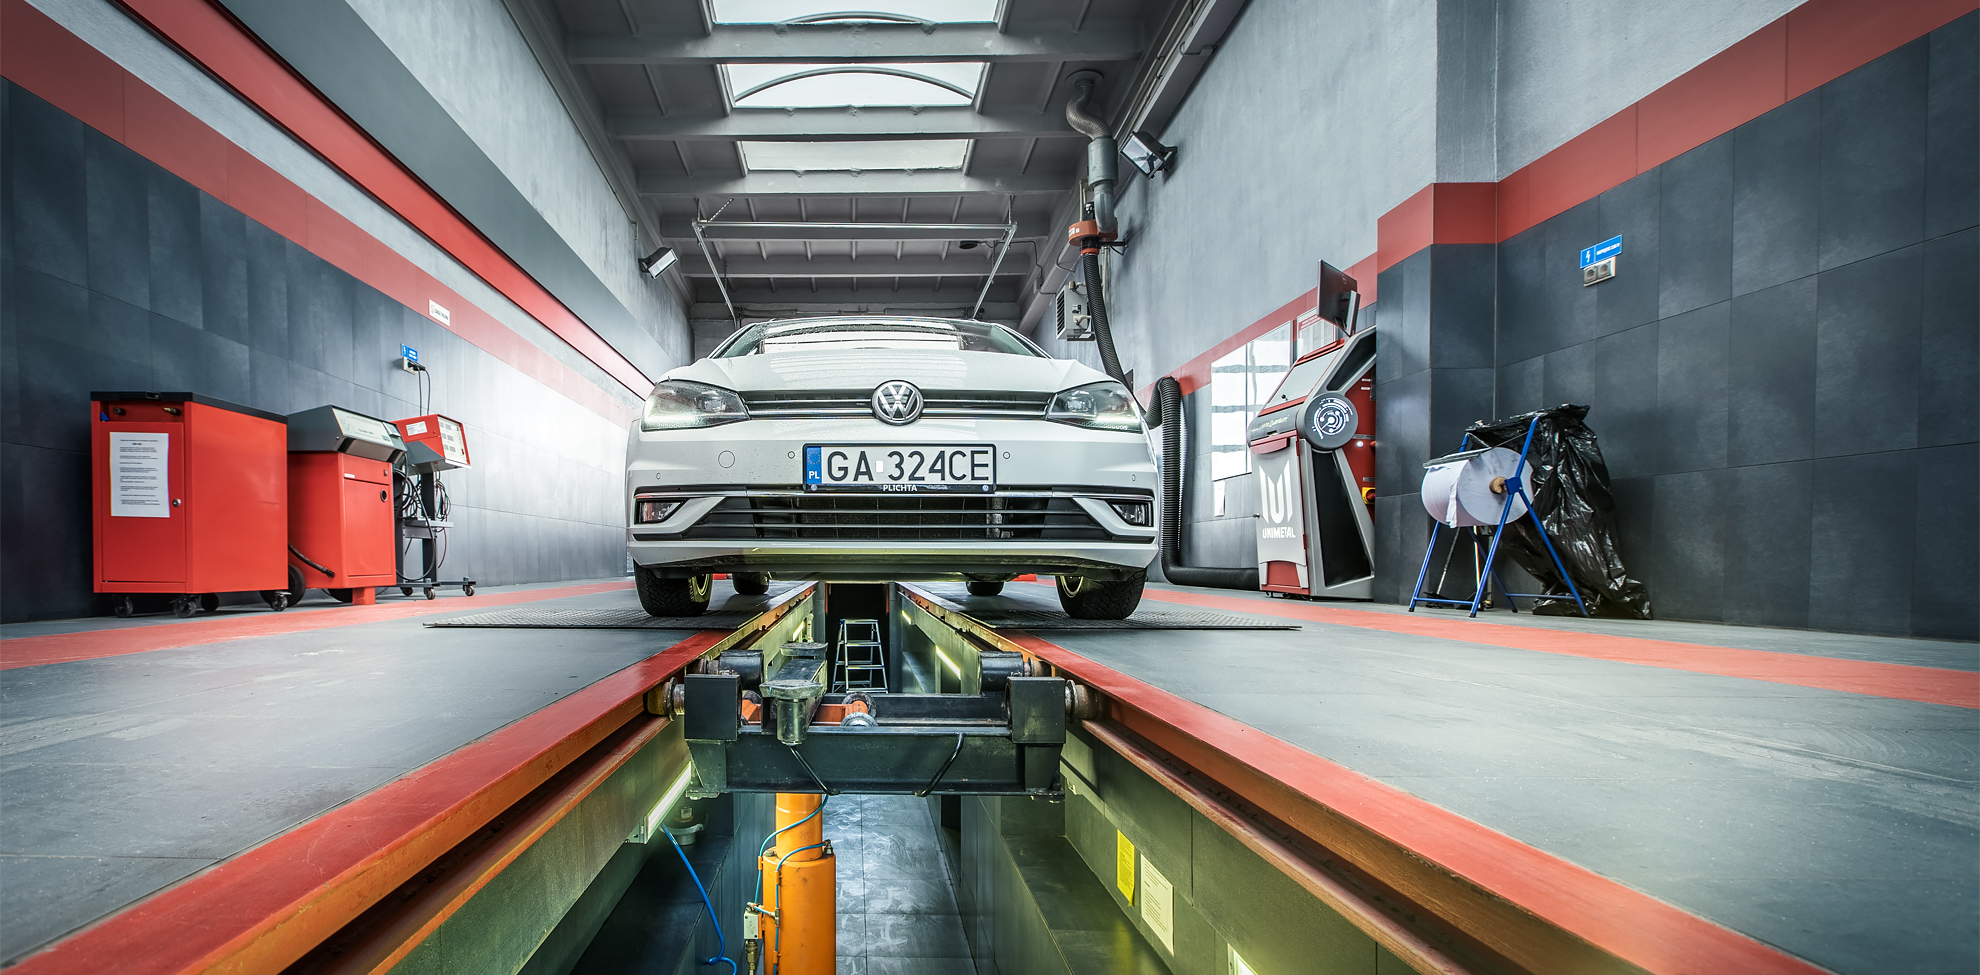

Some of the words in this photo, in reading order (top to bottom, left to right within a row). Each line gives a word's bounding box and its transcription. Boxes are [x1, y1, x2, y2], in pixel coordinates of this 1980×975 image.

[827, 450, 874, 482] GA
[887, 450, 989, 482] 324CE
[808, 471, 820, 480] PL
[883, 484, 918, 492] PLICHTA
[1262, 526, 1297, 539] UNIMETAL
